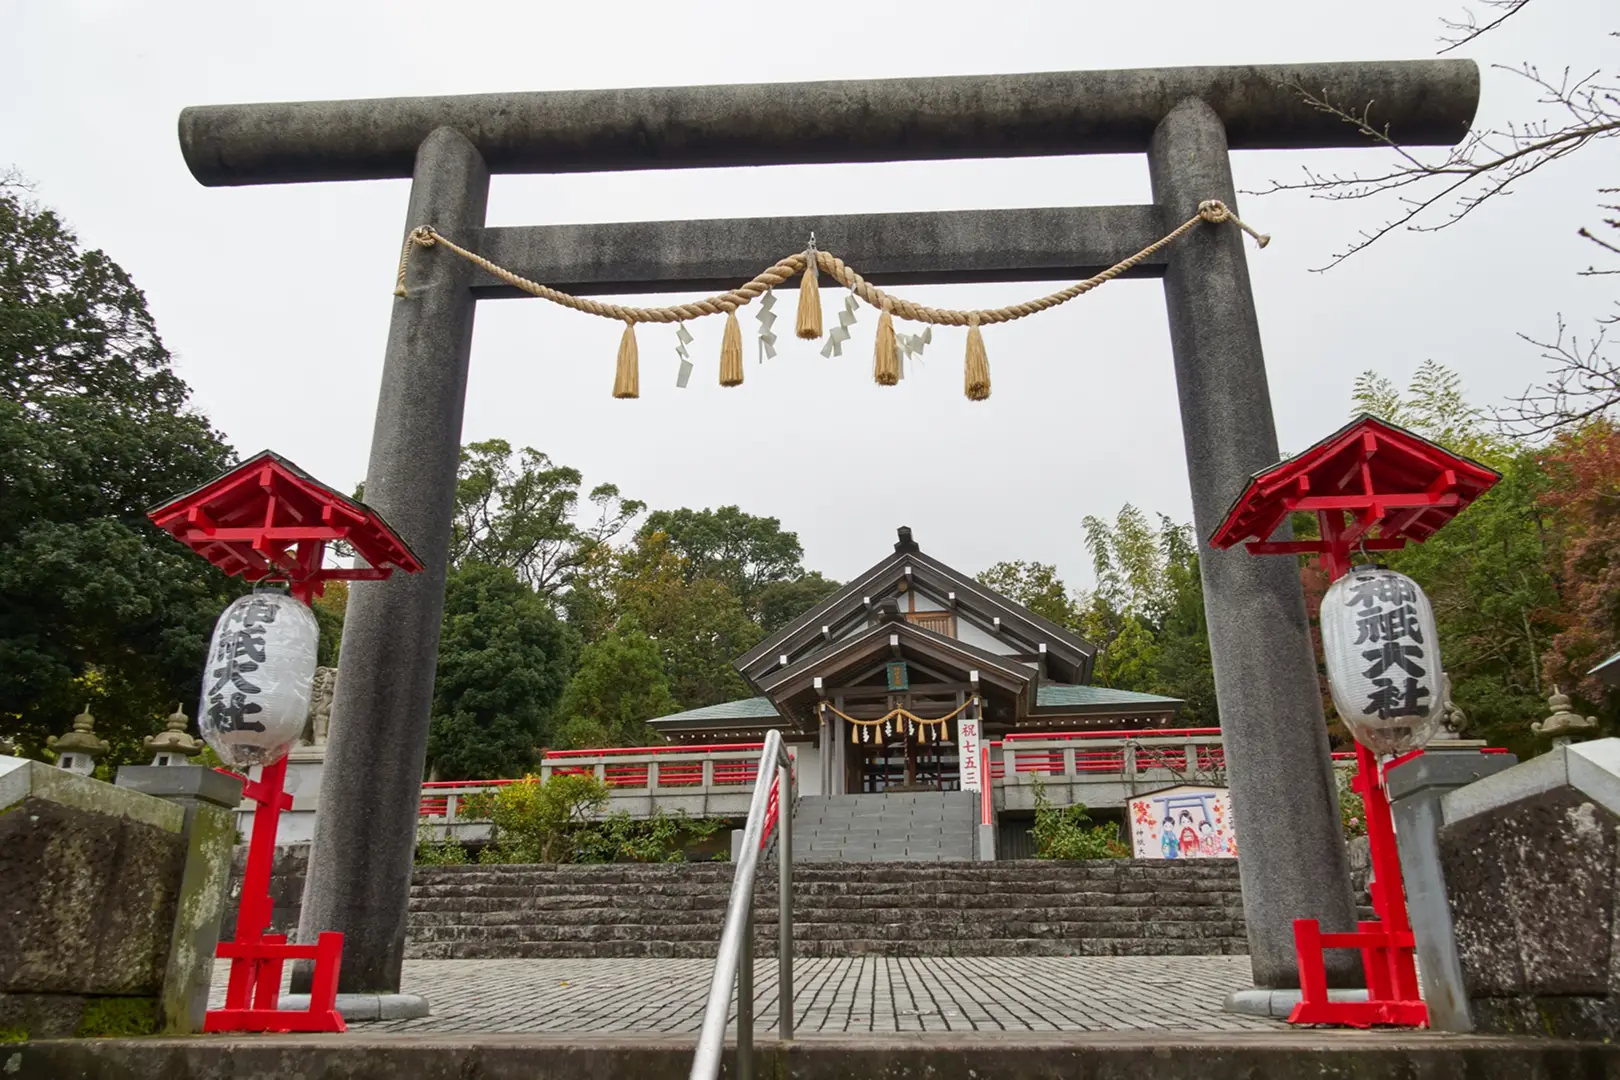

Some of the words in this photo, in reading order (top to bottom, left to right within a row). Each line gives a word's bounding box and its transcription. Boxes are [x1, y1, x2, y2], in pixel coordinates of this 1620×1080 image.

[1345, 574, 1431, 721] 神祇大社
[961, 723, 978, 785] 祝七五三
[1135, 828, 1147, 859] 神祇大
